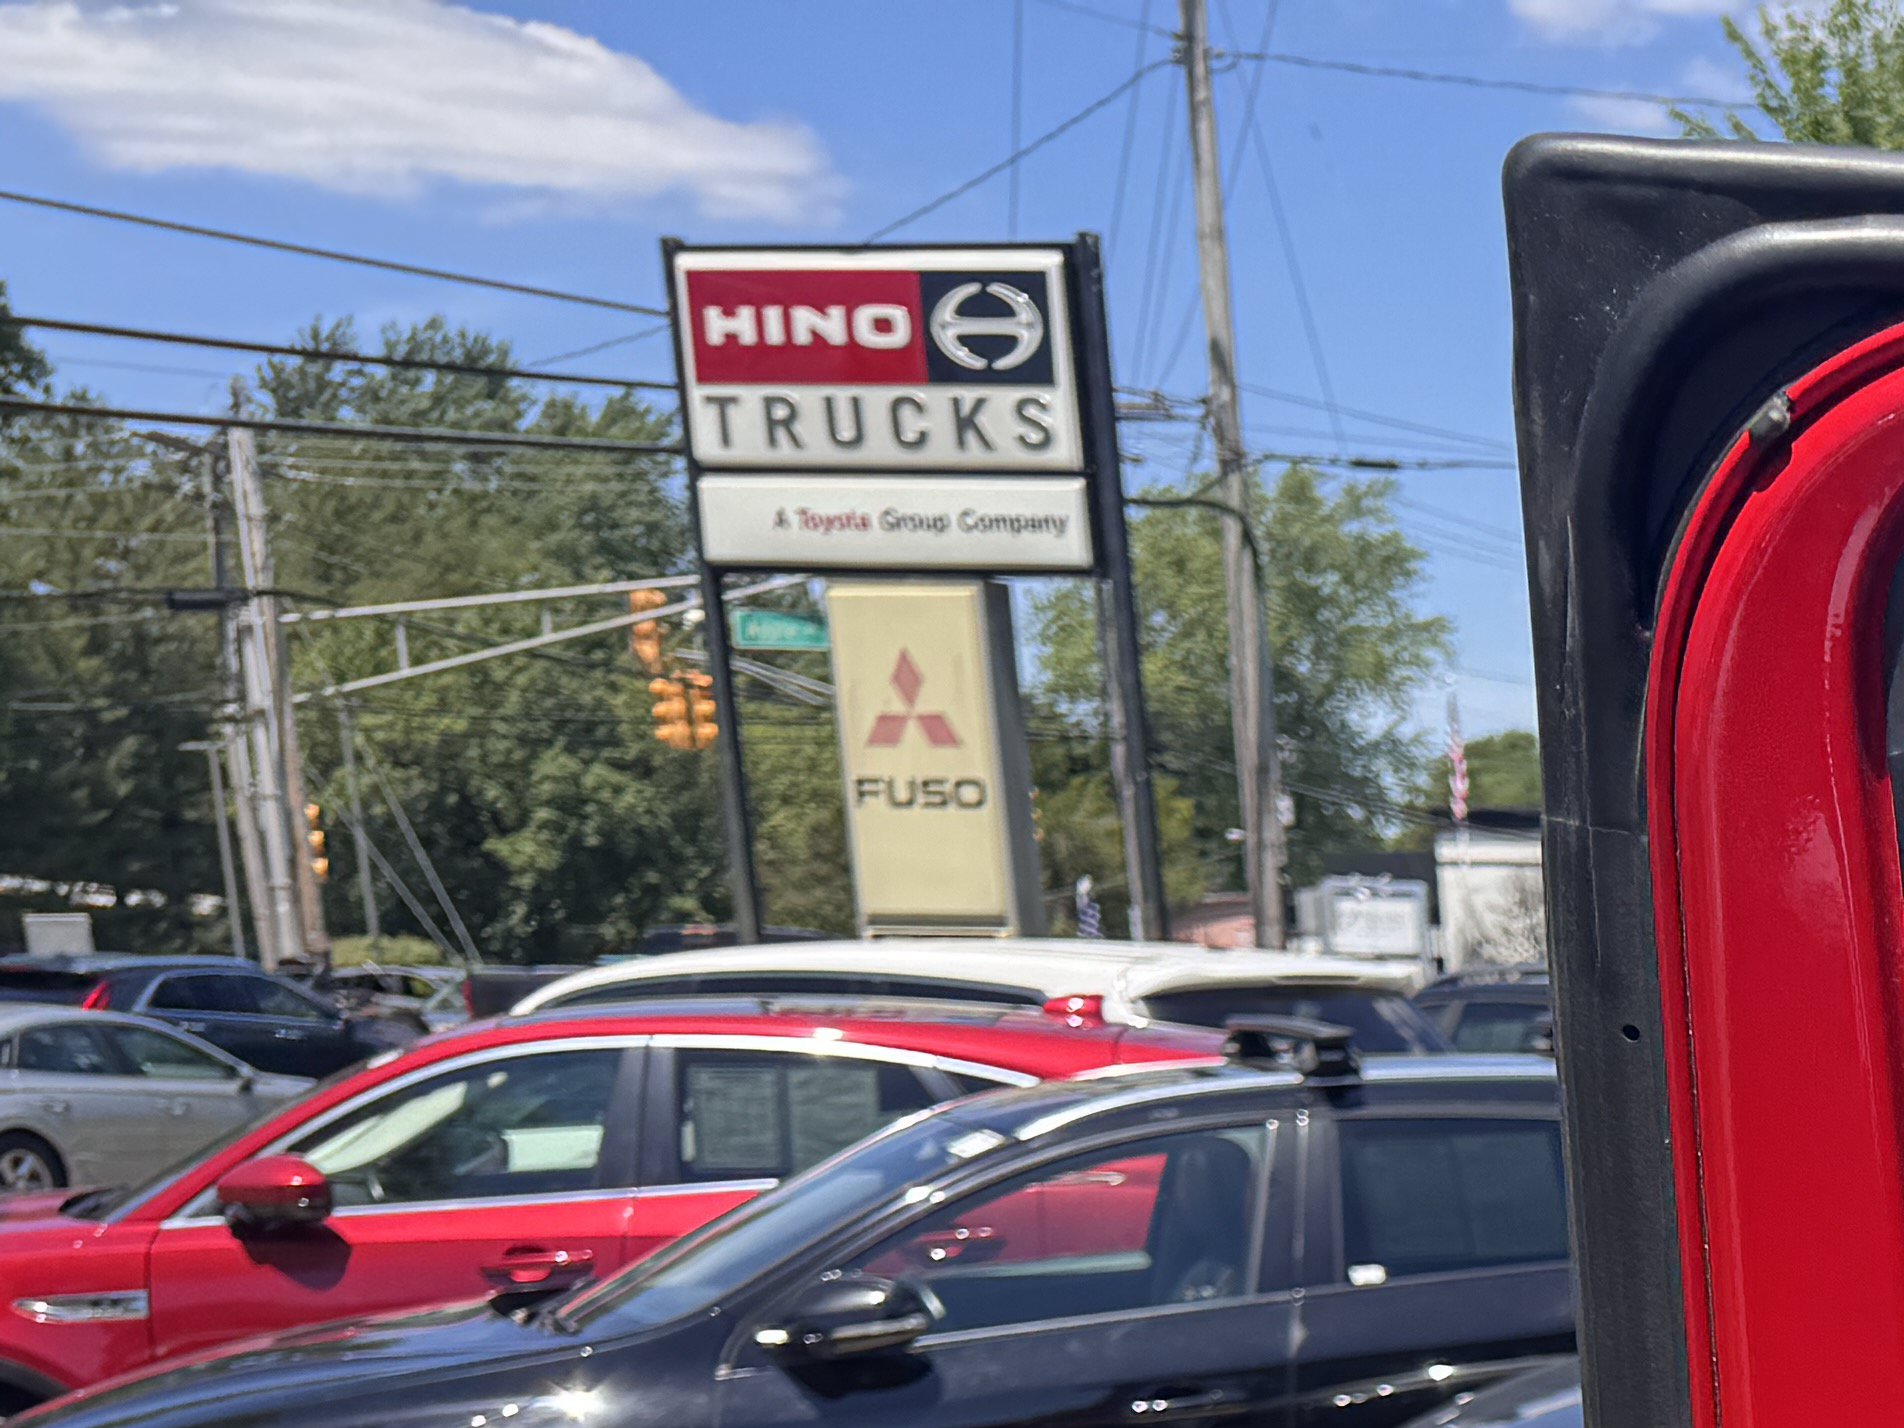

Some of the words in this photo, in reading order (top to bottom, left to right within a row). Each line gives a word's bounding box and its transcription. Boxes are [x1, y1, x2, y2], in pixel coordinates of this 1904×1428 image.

[702, 303, 913, 350] HINO
[704, 395, 1054, 451] TRUCKS
[773, 507, 791, 530] A
[796, 507, 871, 535] Toyota
[879, 508, 950, 533] Group
[957, 508, 1069, 537] Company
[855, 777, 987, 809] FUSO
